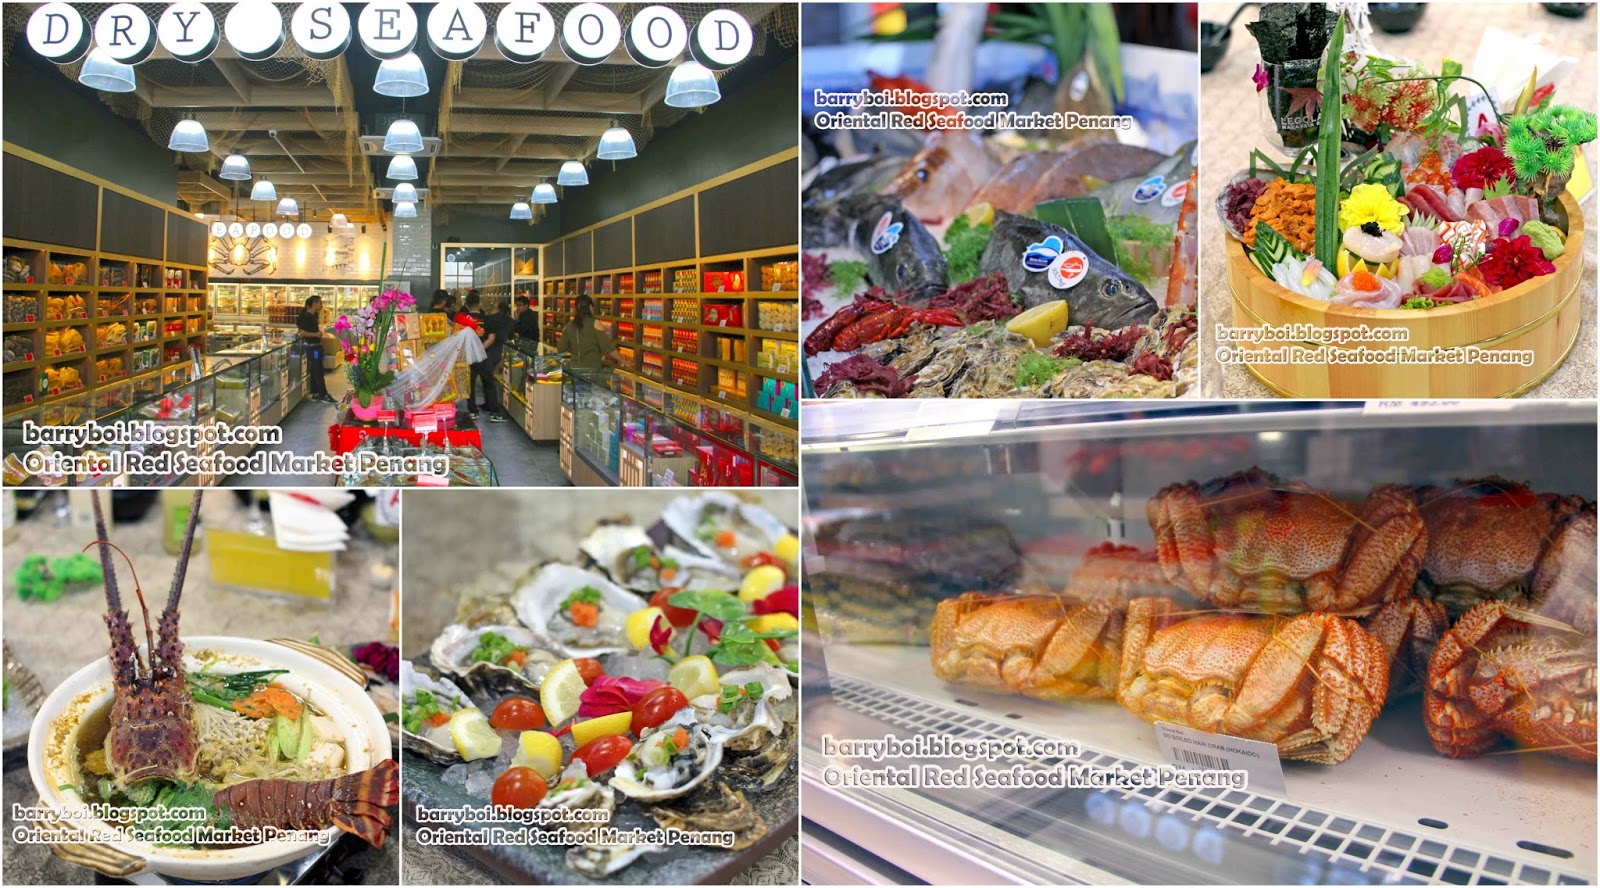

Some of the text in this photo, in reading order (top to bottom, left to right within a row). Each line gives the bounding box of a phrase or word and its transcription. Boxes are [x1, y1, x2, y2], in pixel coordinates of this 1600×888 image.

[42, 8, 740, 51] DRY SEAFOOD
[1171, 734, 1193, 744] BOILED
[1193, 739, 1207, 748] HAIR
[1207, 742, 1226, 752] CRAB
